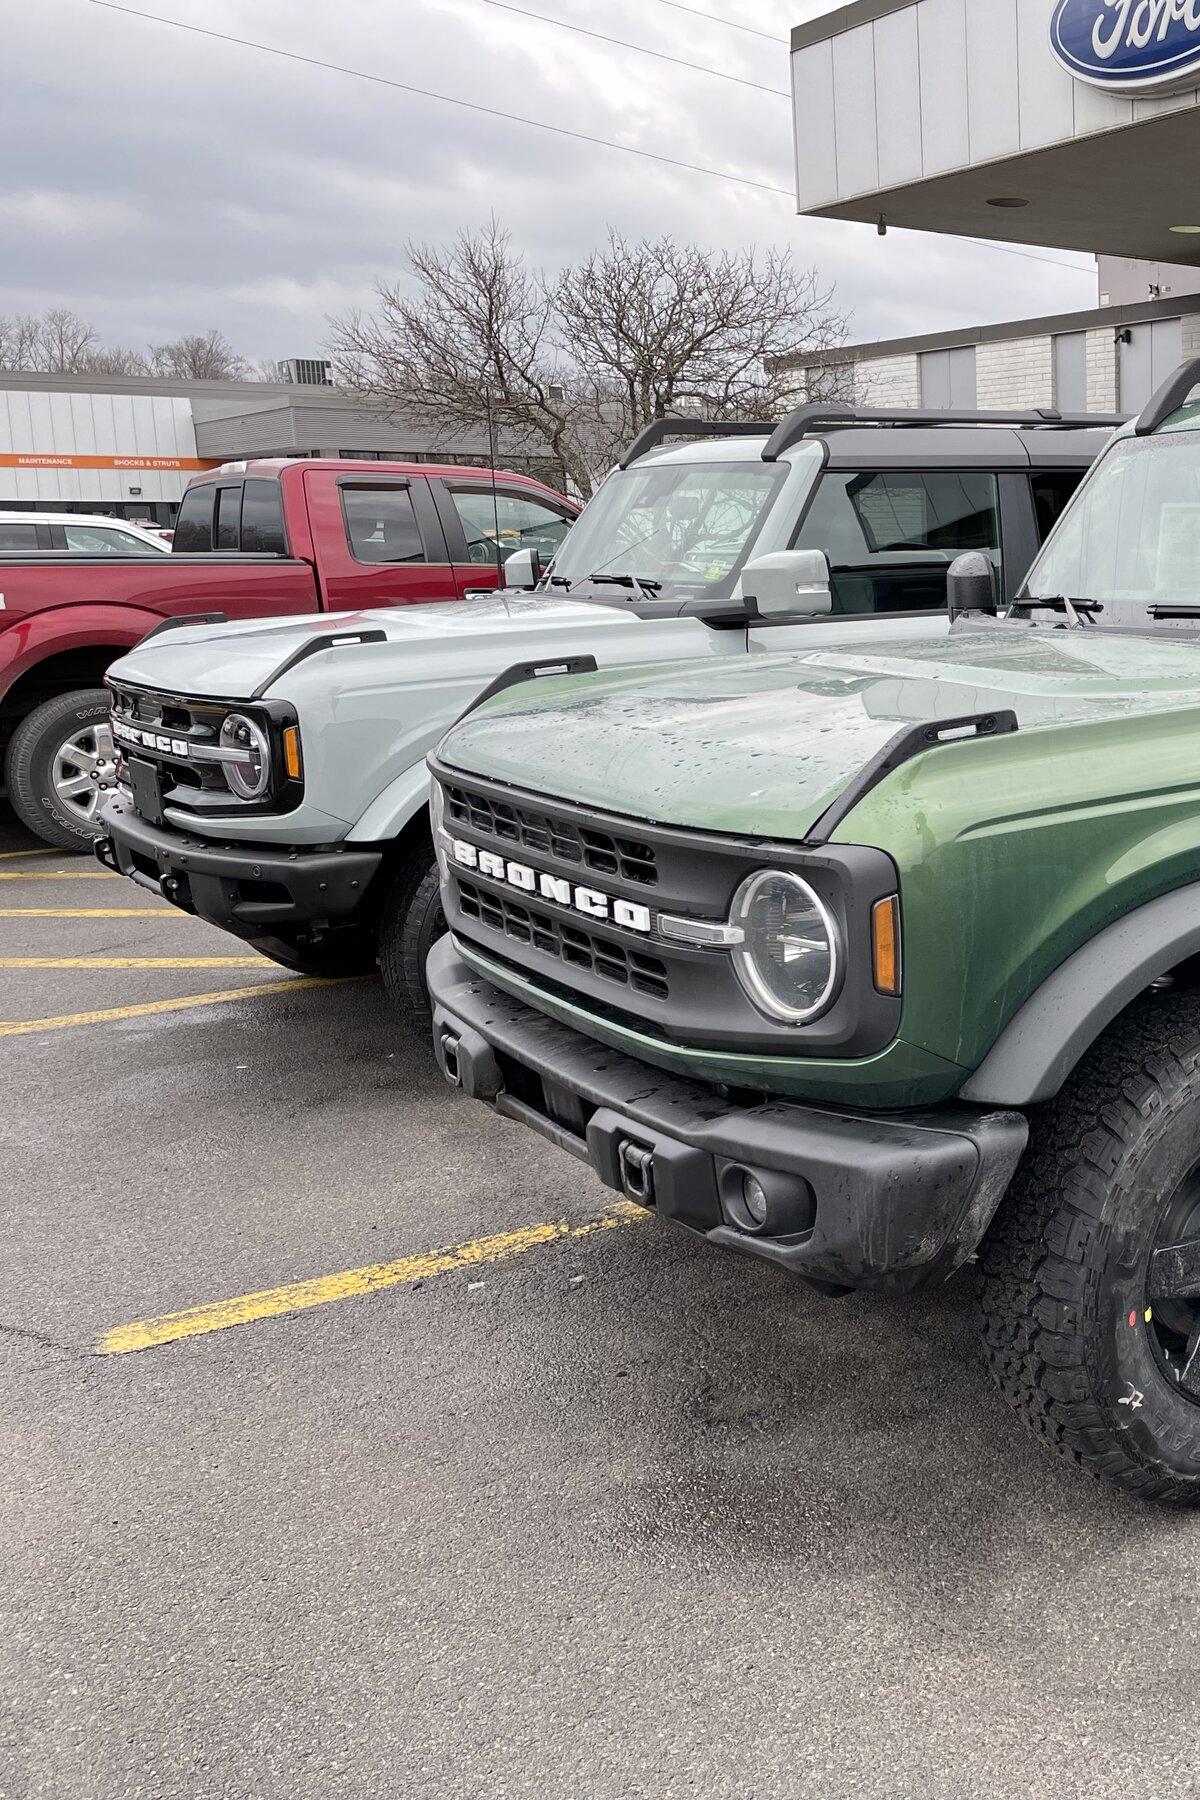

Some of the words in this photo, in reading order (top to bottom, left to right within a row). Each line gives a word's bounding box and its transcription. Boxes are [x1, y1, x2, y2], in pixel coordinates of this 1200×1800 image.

[18, 457, 73, 465] MAINTENANCE
[113, 459, 145, 467] SHOCKS
[152, 460, 181, 468] STRUTS
[454, 839, 650, 932] BRONCO
